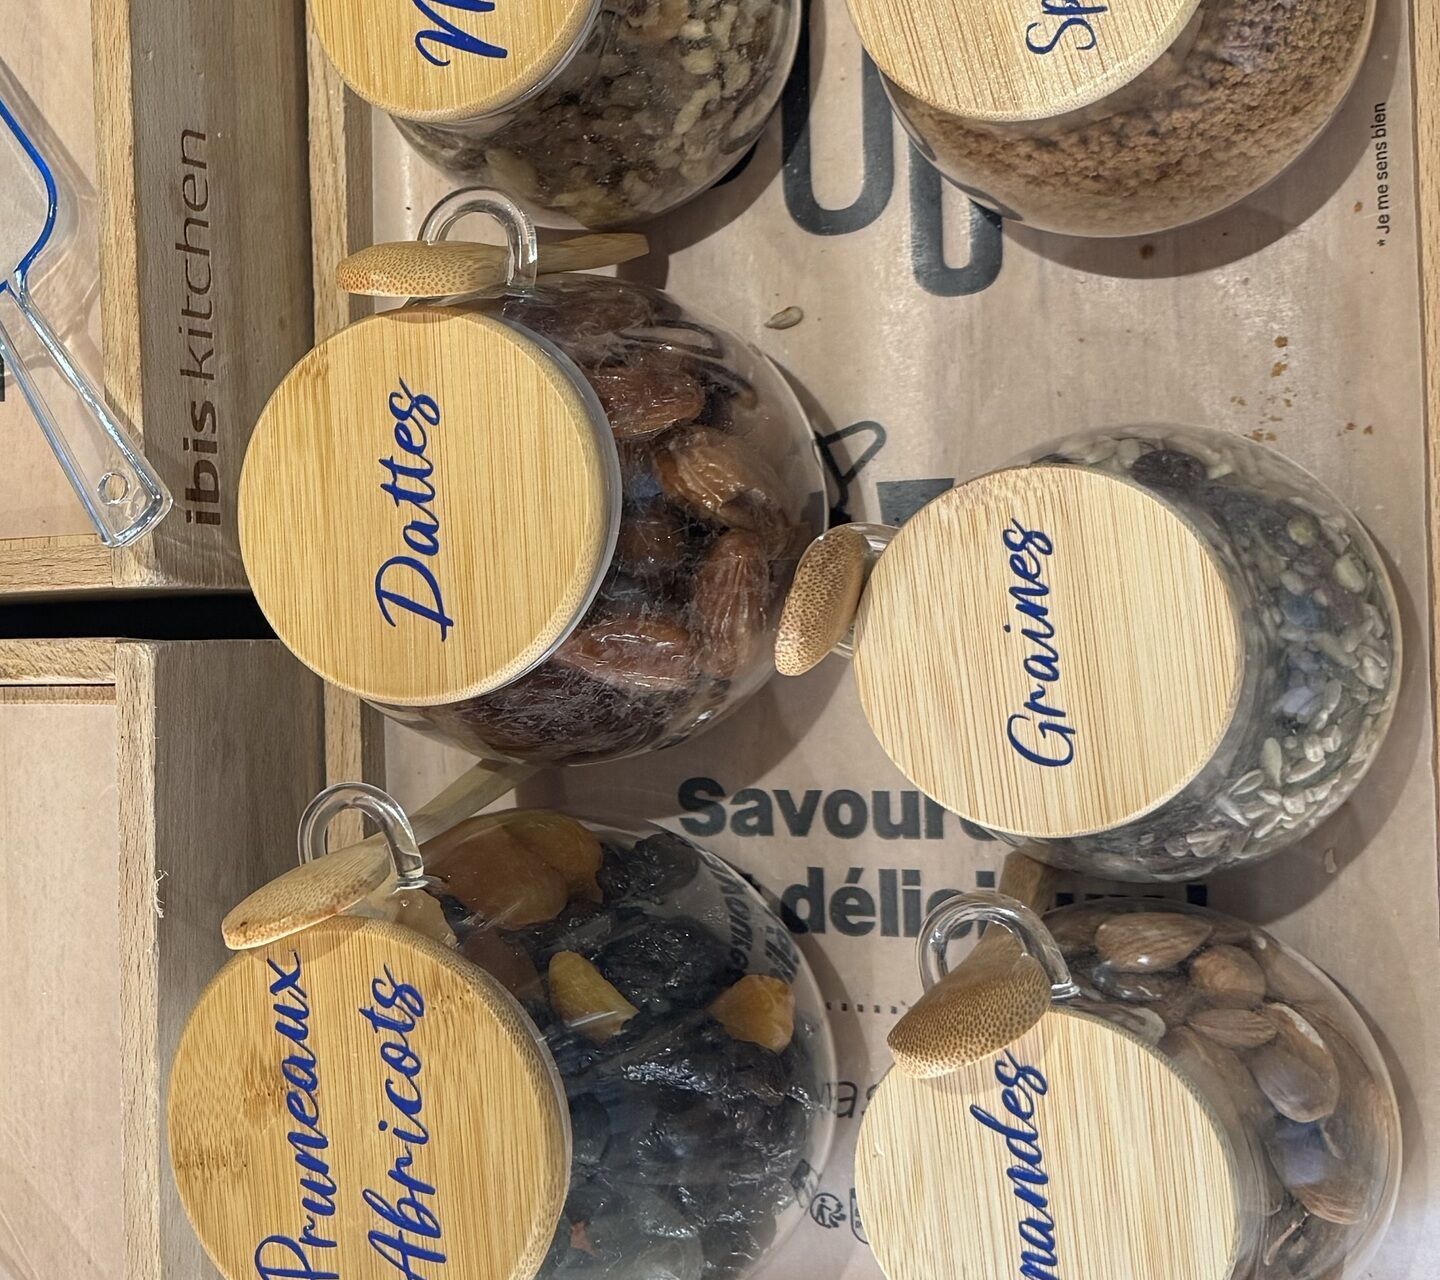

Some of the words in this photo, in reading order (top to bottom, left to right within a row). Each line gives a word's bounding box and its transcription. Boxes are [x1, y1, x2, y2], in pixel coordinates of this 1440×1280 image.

[1369, 101, 1388, 140] bien
[1372, 141, 1389, 180] sens
[1374, 183, 1390, 210] me
[1375, 213, 1391, 235] Je
[175, 128, 216, 382] kitchen
[182, 399, 222, 527] ibis
[373, 376, 455, 643] Dattes
[1000, 515, 1077, 768] Graines
